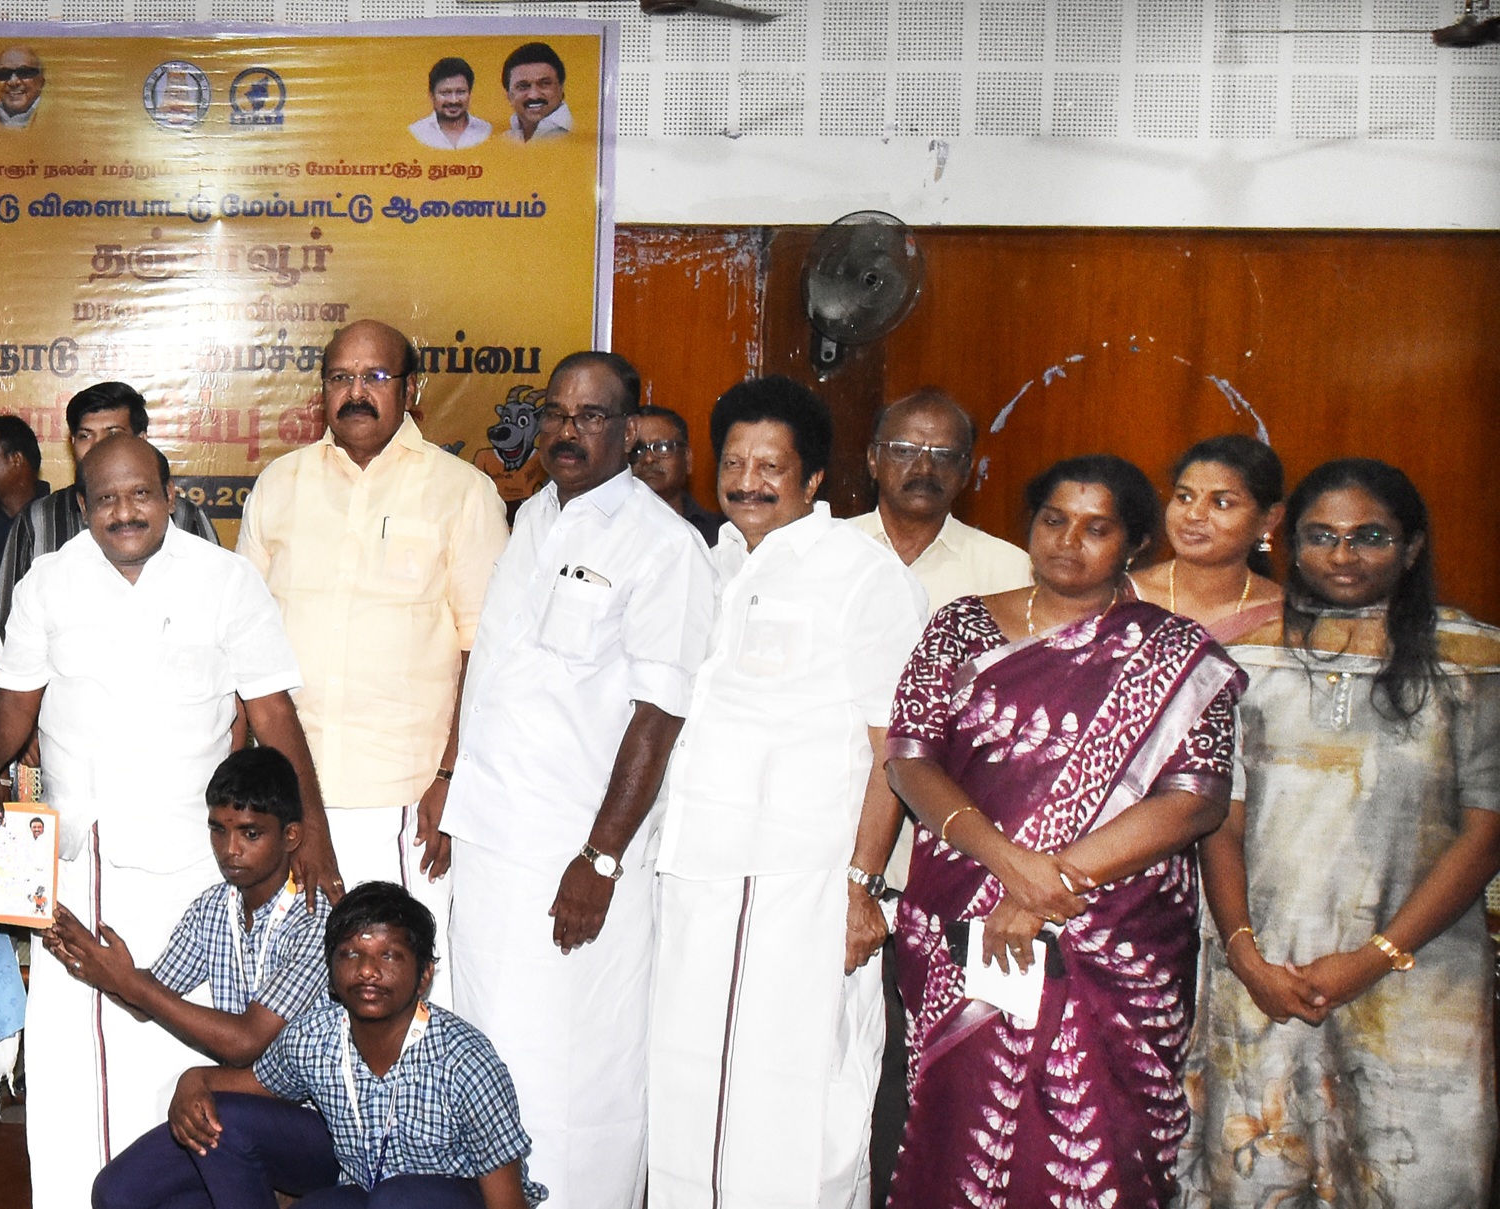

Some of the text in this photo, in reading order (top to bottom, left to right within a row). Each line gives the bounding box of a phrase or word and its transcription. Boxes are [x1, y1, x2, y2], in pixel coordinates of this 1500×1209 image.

[43, 159, 97, 179] நலன்
[306, 159, 423, 180] மேம்பாட்டுத்
[428, 163, 483, 180] துறை
[28, 192, 212, 223] விளையாட்டு
[220, 192, 373, 223] மேம்பாட்டு
[381, 193, 547, 224] ஆணையம்
